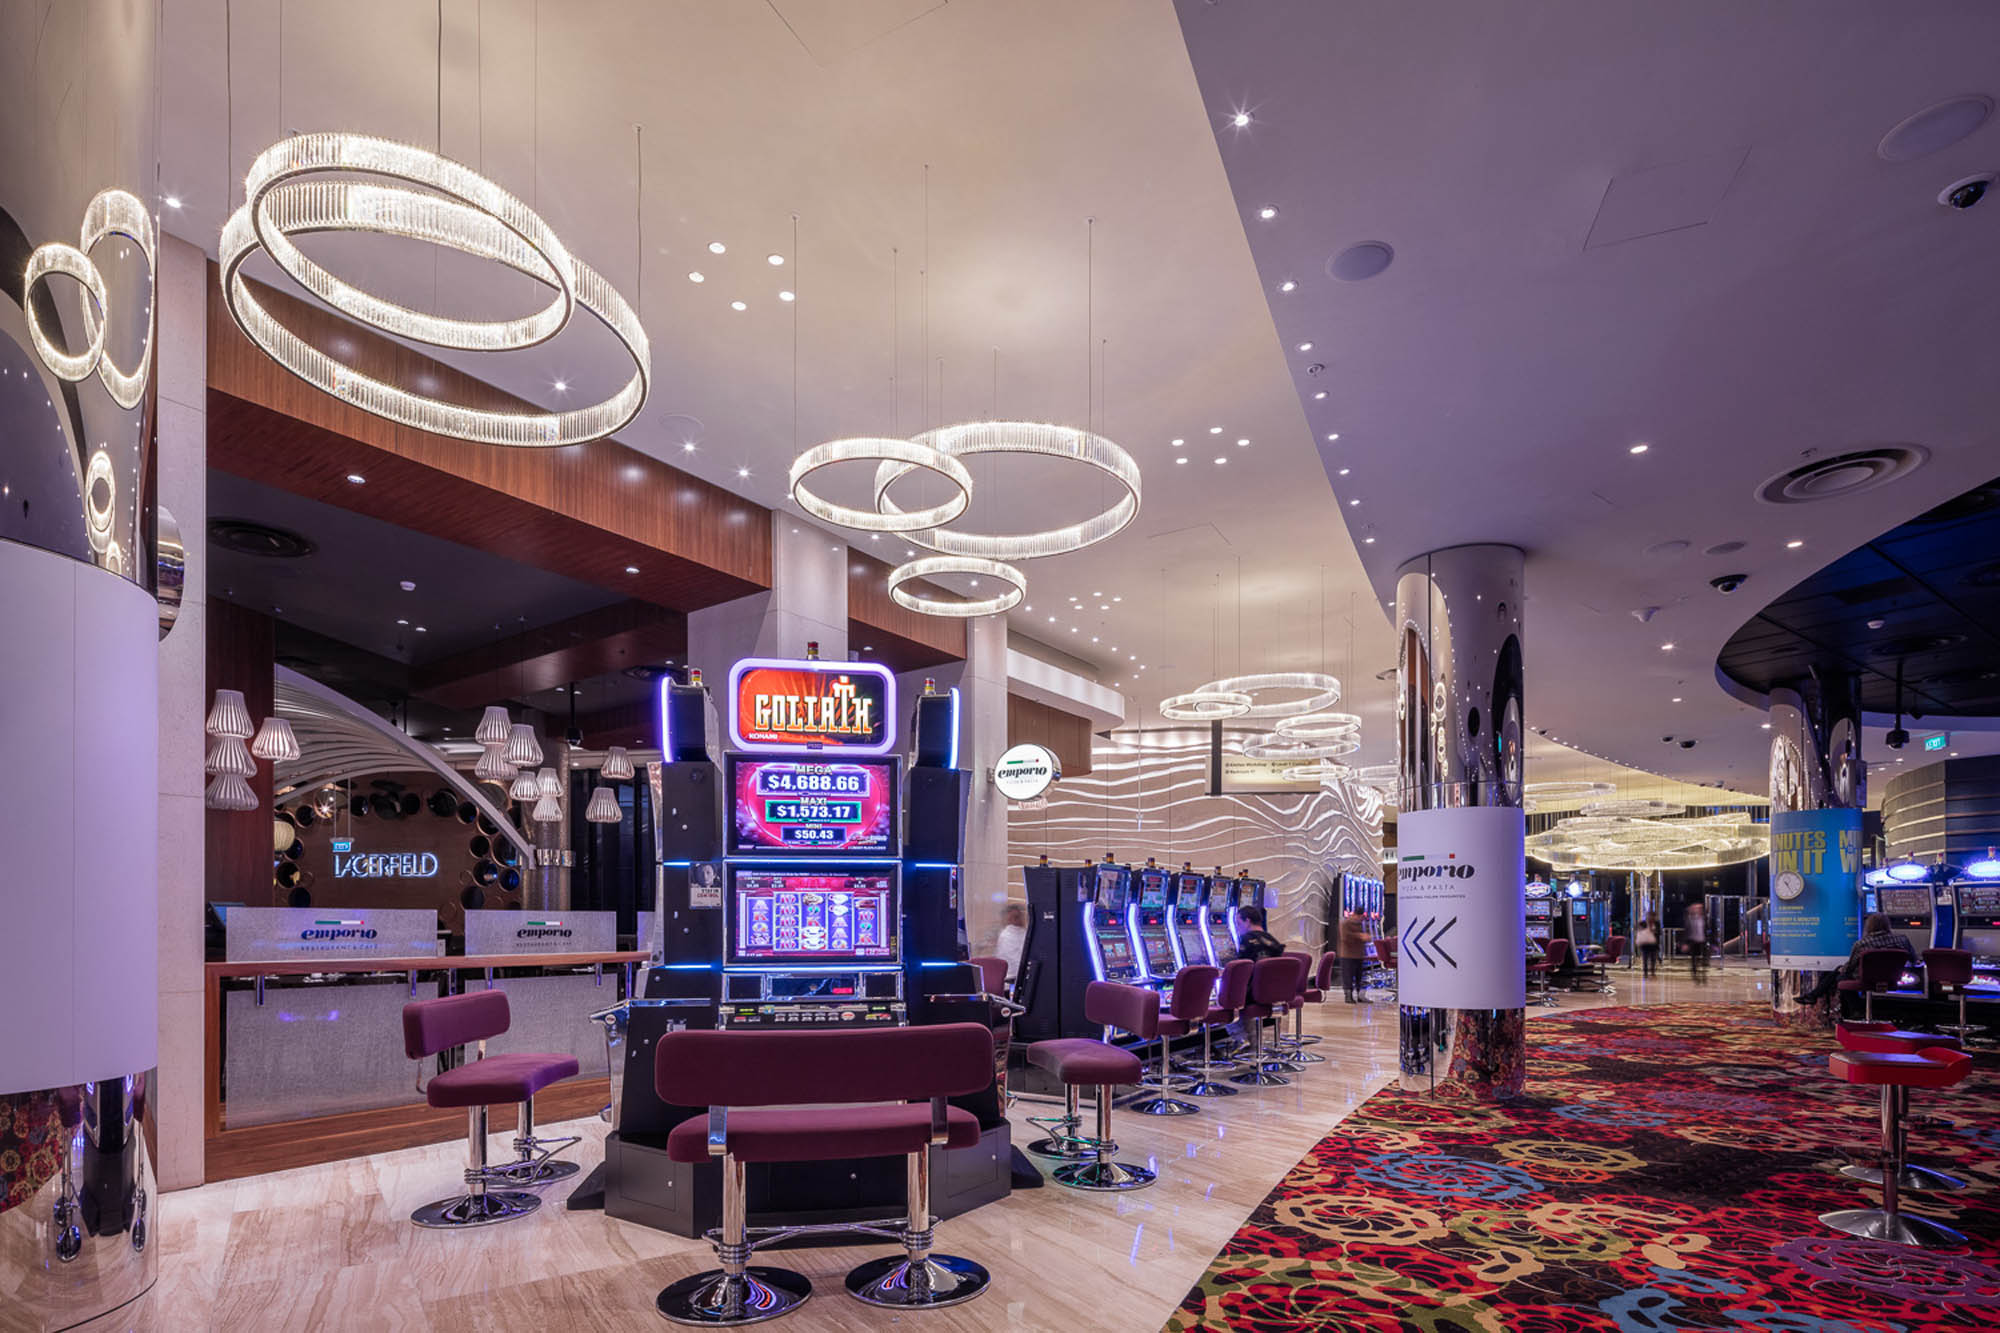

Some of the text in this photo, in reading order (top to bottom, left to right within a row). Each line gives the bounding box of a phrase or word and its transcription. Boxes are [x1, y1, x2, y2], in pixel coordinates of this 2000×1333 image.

[754, 675, 873, 735] GOLIATH
[795, 765, 833, 775] MEGA
[997, 767, 1048, 779] emporio
[768, 774, 860, 791] $4,688.66
[800, 797, 827, 806] MAXI
[777, 805, 850, 818] $1,573.17
[794, 830, 834, 839] $50.43
[335, 853, 439, 878] LAGERFELD
[1803, 849, 1827, 874] IT
[1398, 864, 1475, 882] mporio
[301, 929, 378, 941] emporio
[517, 929, 572, 939] emporio
